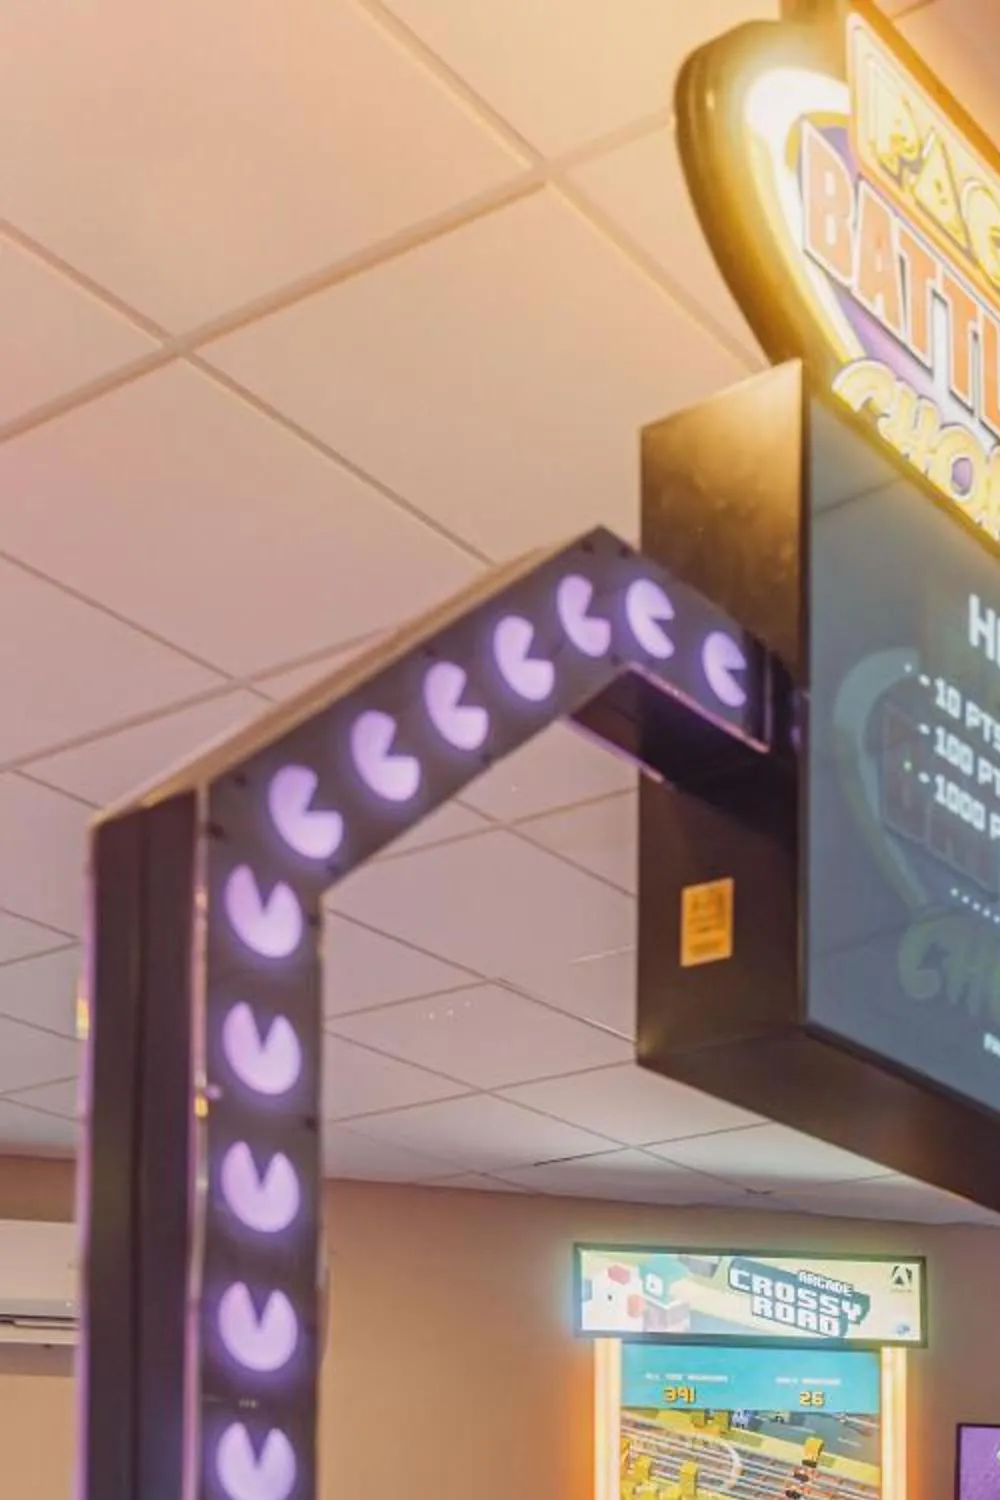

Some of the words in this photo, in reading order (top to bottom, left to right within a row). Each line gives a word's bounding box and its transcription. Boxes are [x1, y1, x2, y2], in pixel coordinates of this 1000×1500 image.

[934, 678, 961, 720] 10
[934, 726, 973, 776] 100
[934, 774, 986, 833] 1000
[728, 1266, 863, 1323] CROSSY
[798, 1269, 853, 1296] ARCADE
[751, 1295, 841, 1337] ROAD
